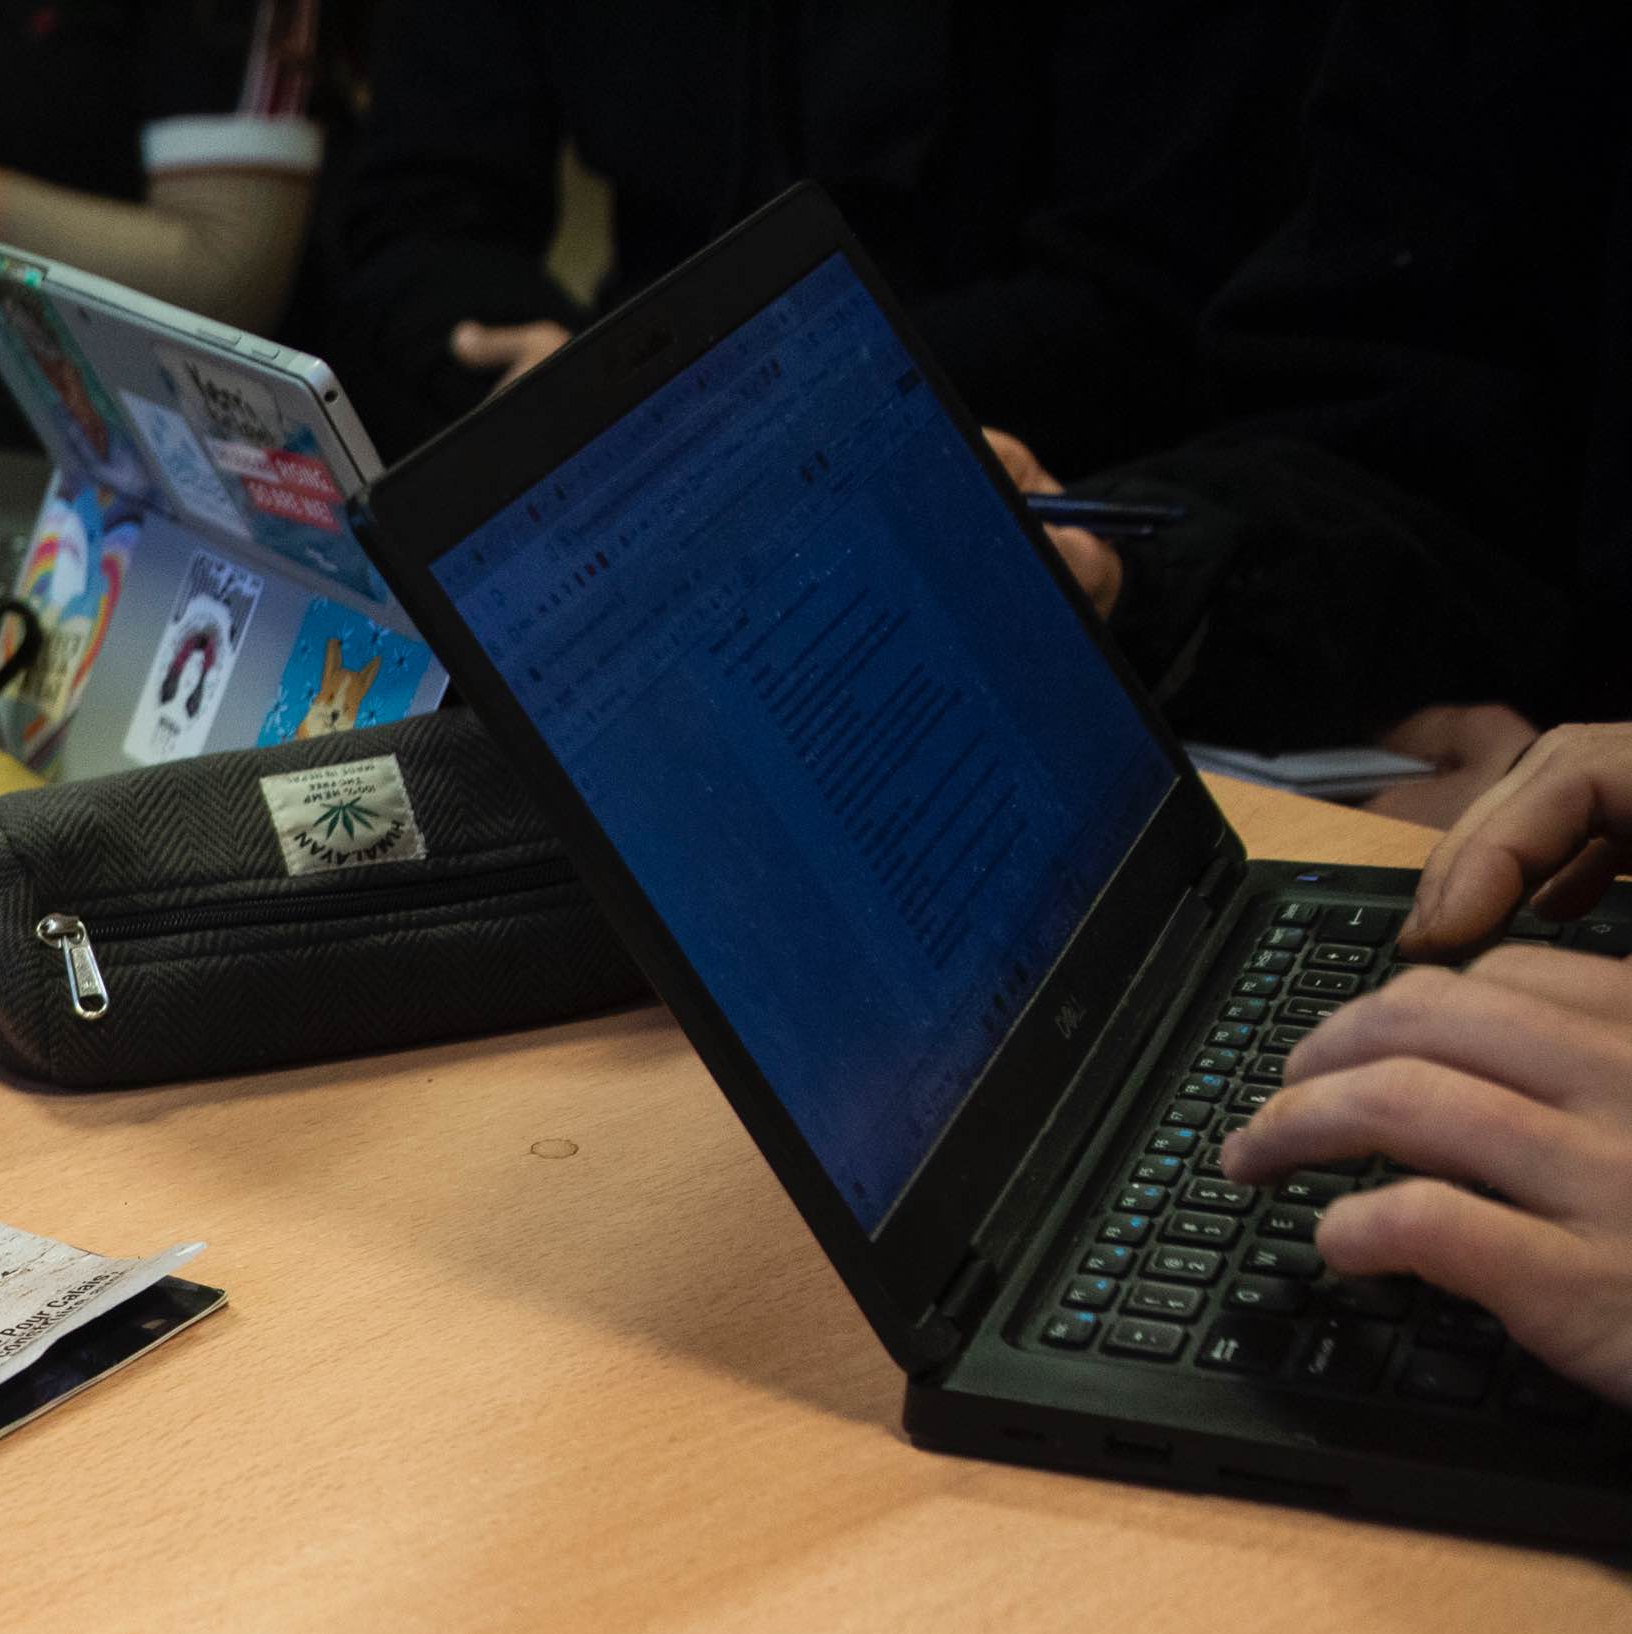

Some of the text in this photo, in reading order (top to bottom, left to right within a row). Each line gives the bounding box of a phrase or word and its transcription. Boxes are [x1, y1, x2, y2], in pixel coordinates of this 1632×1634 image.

[303, 789, 341, 804] HEMP
[1271, 1217, 1295, 1230] E
[1248, 1250, 1278, 1267] W
[0, 1309, 51, 1338] Pour
